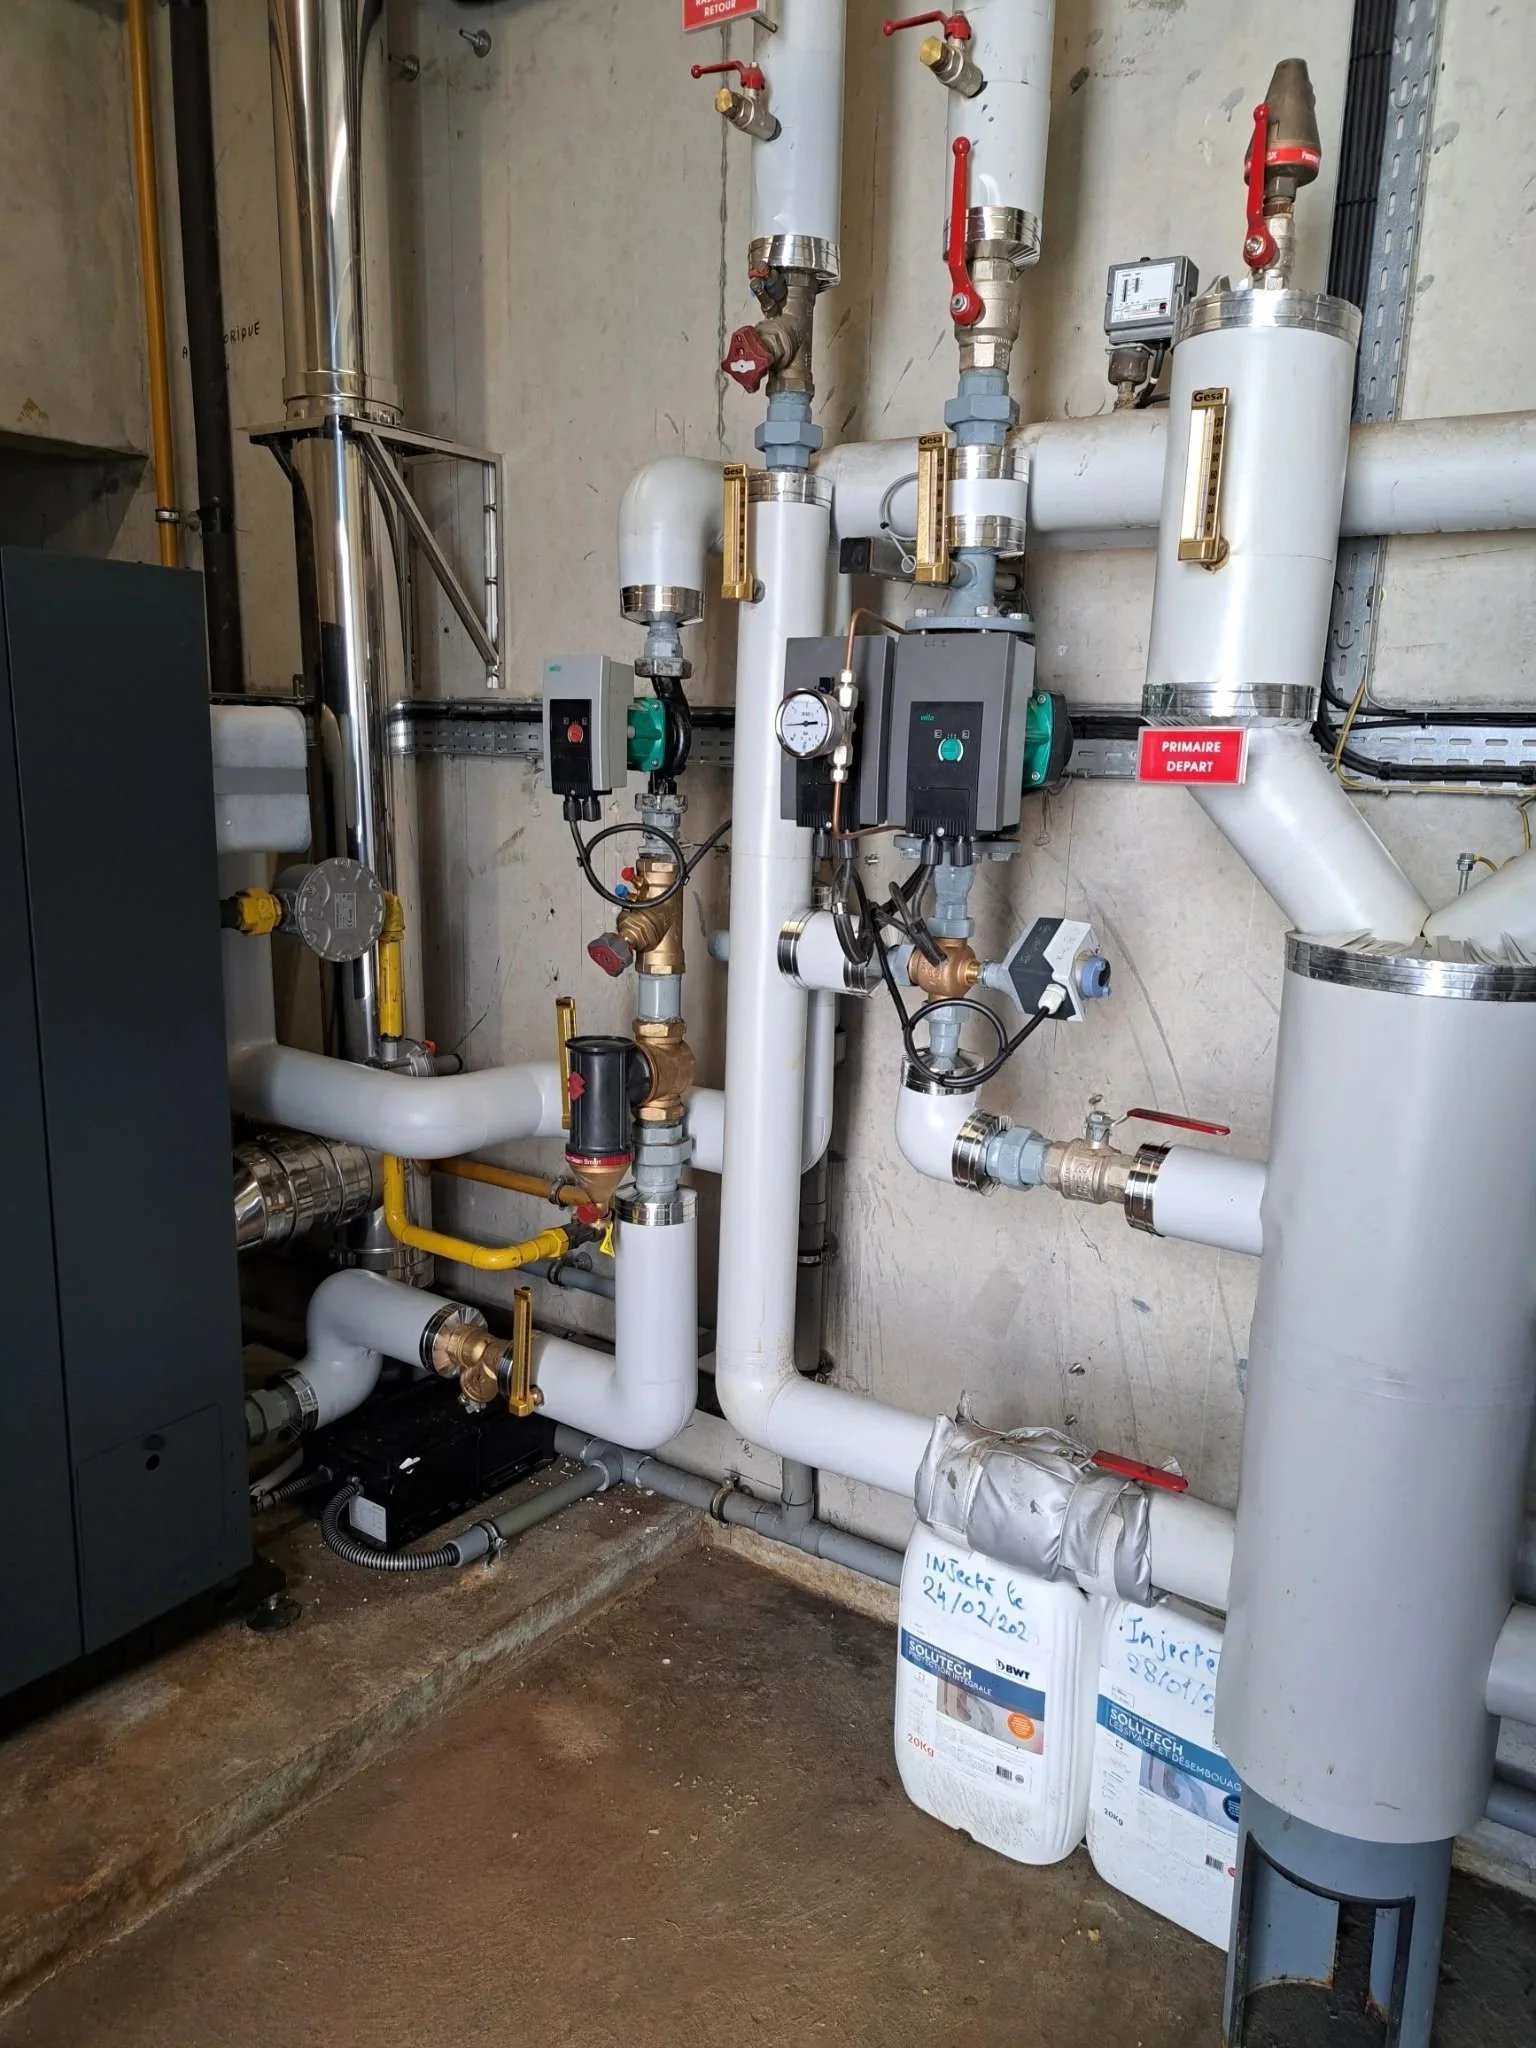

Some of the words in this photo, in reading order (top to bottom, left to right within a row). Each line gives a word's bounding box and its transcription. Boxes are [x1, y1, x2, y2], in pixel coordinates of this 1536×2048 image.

[704, 0, 736, 17] RETOUR
[1193, 391, 1224, 403] Gesa
[919, 436, 943, 446] Gesa
[723, 467, 744, 476] Gesa
[920, 713, 935, 721] wilo
[1161, 741, 1222, 753] PRIMAIRE
[1166, 760, 1214, 773] DEPART
[922, 1575, 1038, 1645] 24/02/202
[1125, 1616, 1221, 1676] Injecté
[909, 1639, 972, 1681] SOLUTECH
[908, 1649, 951, 1677] PROTECTION
[952, 1671, 992, 1696] INTÉGRALE
[1005, 1664, 1031, 1681] BWT
[1110, 1708, 1184, 1756] SOLUTECH
[907, 1733, 935, 1758] 20Kg
[1109, 1718, 1156, 1751] LESSIVAGE
[1158, 1745, 1170, 1758] ET
[1171, 1753, 1242, 1792] DÉSEMBOUAG
[1103, 1807, 1124, 1827] 20Kg
